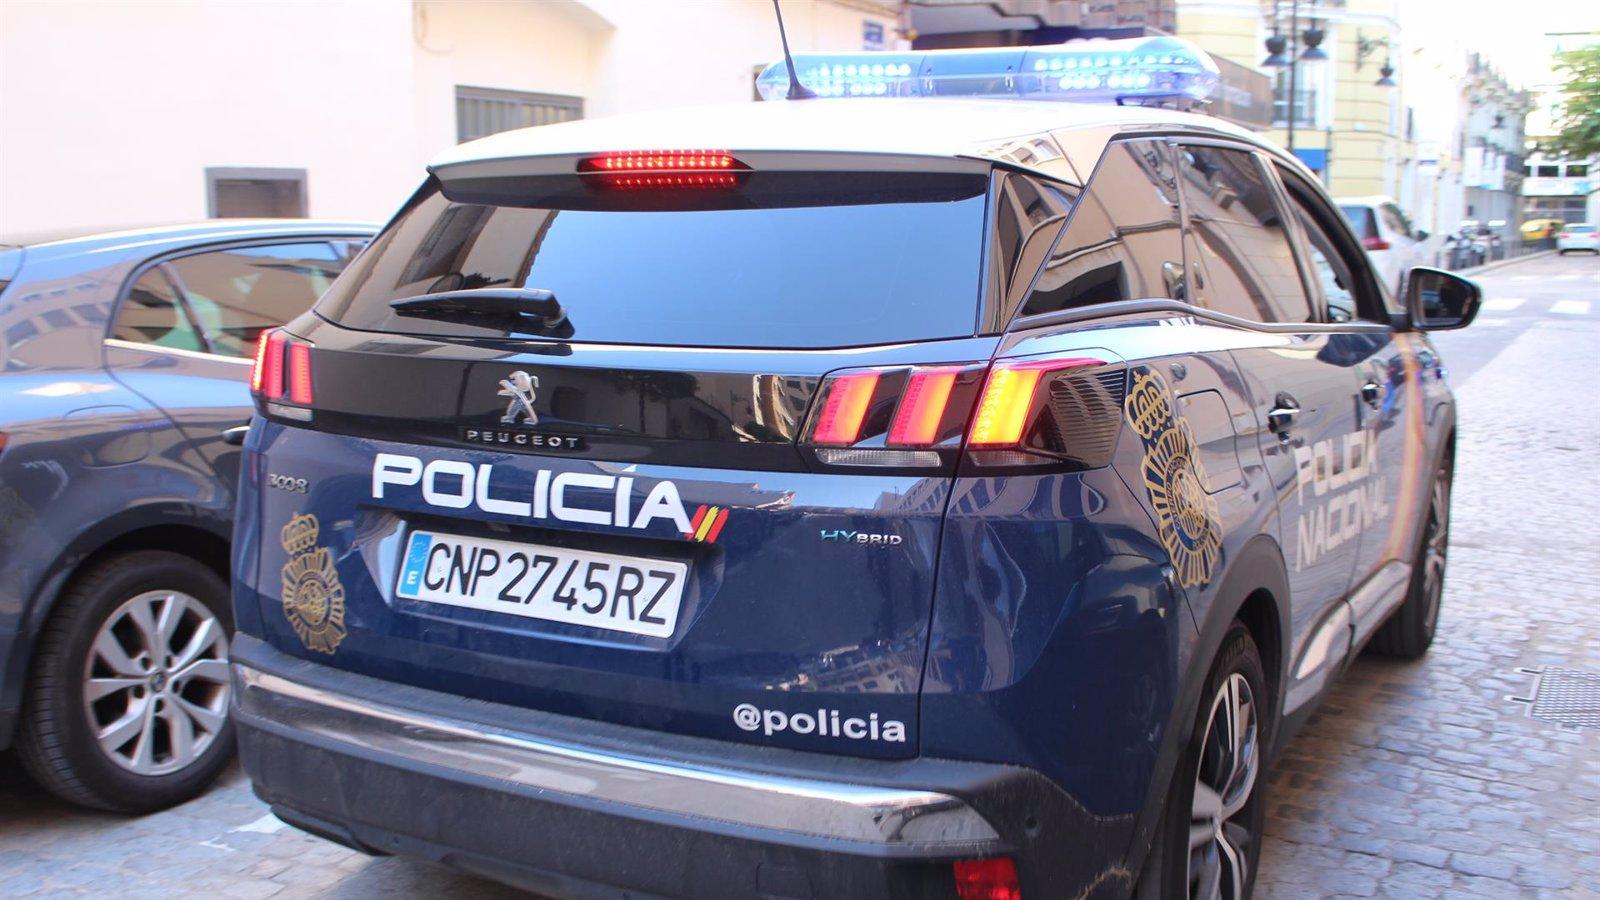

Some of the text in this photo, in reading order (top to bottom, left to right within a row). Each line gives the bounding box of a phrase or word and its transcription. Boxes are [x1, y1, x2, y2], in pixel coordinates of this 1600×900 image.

[466, 429, 579, 449] PEUGEOT
[268, 473, 308, 494] 3008
[372, 453, 695, 534] POLICÍA
[820, 529, 903, 545] HYBRID
[406, 570, 420, 585] E
[732, 702, 907, 743] @policia
